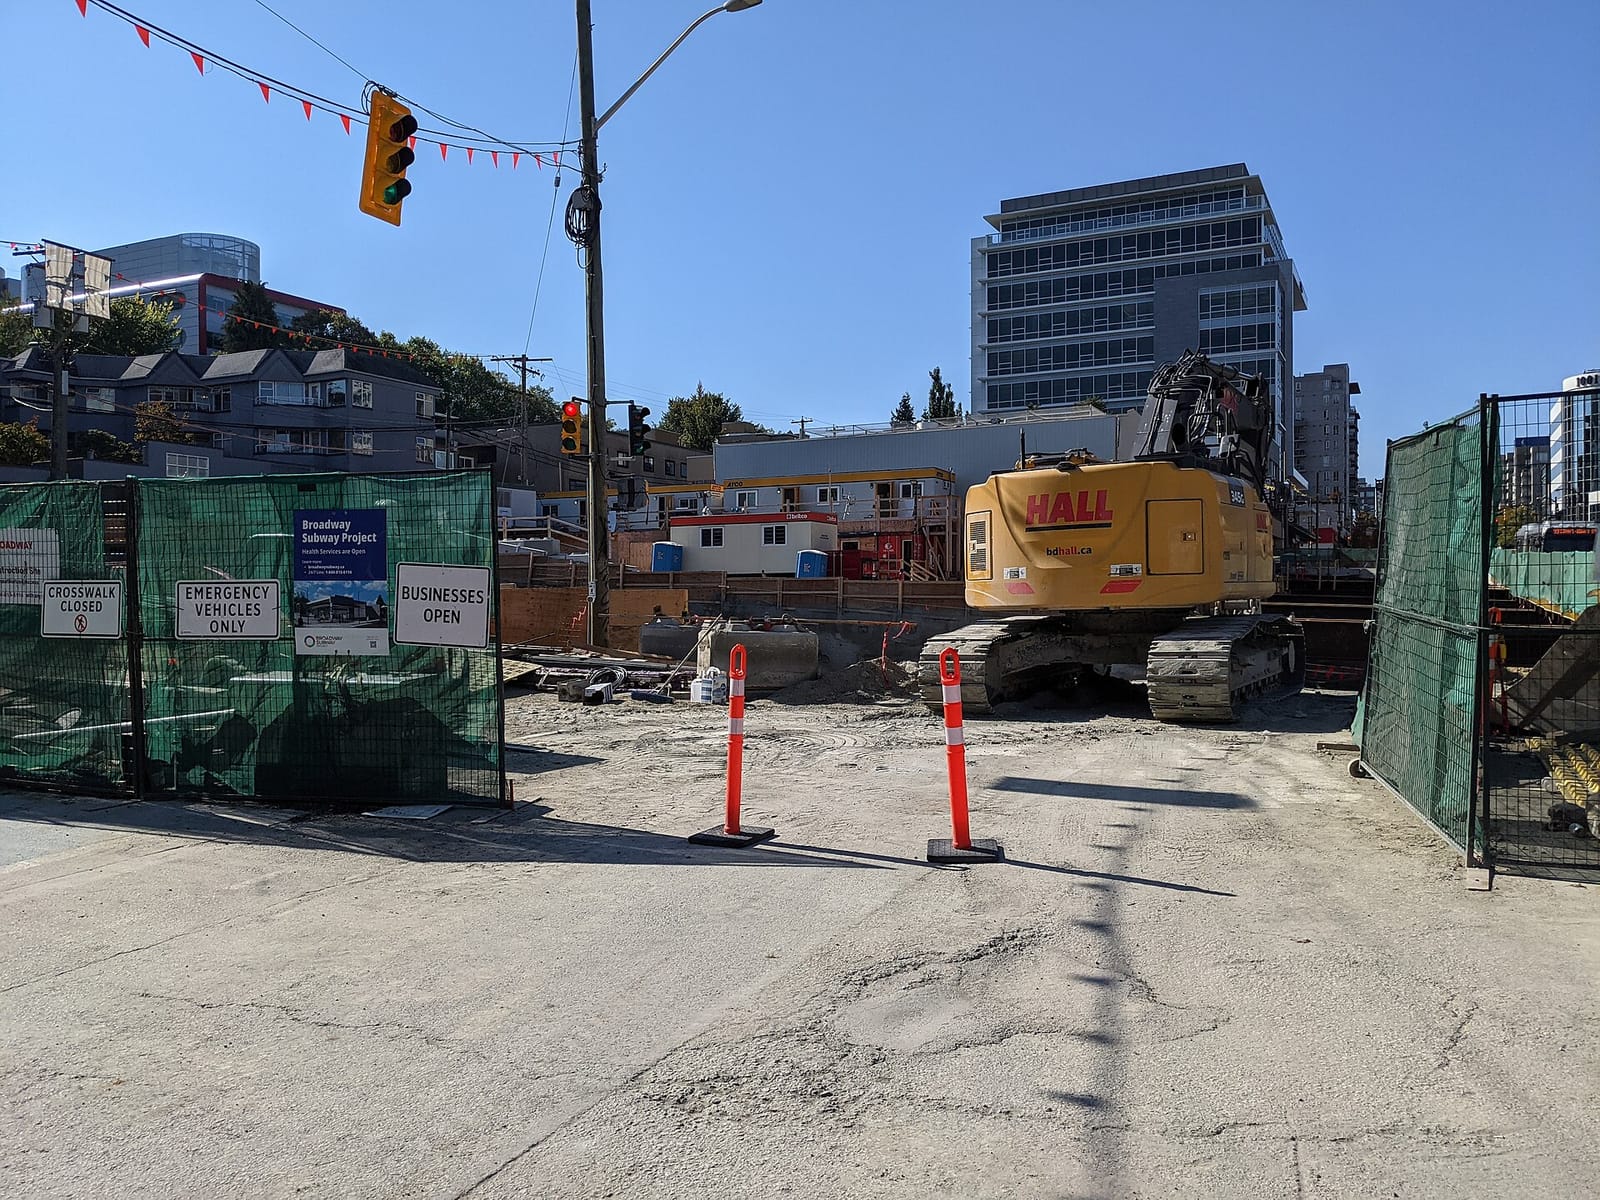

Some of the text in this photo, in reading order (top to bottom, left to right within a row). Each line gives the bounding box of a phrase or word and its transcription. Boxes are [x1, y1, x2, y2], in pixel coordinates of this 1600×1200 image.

[1576, 374, 1599, 388] 1001
[1025, 489, 1113, 525] HALL
[302, 519, 351, 532] Broadway
[302, 532, 377, 546] Subway Project
[1046, 546, 1092, 556] bdhall.ca
[48, 586, 116, 599] CROSSWALK
[185, 586, 270, 600] EMERGENCY
[401, 585, 484, 604] BUSINESSES
[60, 600, 103, 612] CLOSED
[195, 603, 261, 617] VEHICLES
[423, 608, 461, 624] OPEN
[209, 620, 246, 633] ONLY
